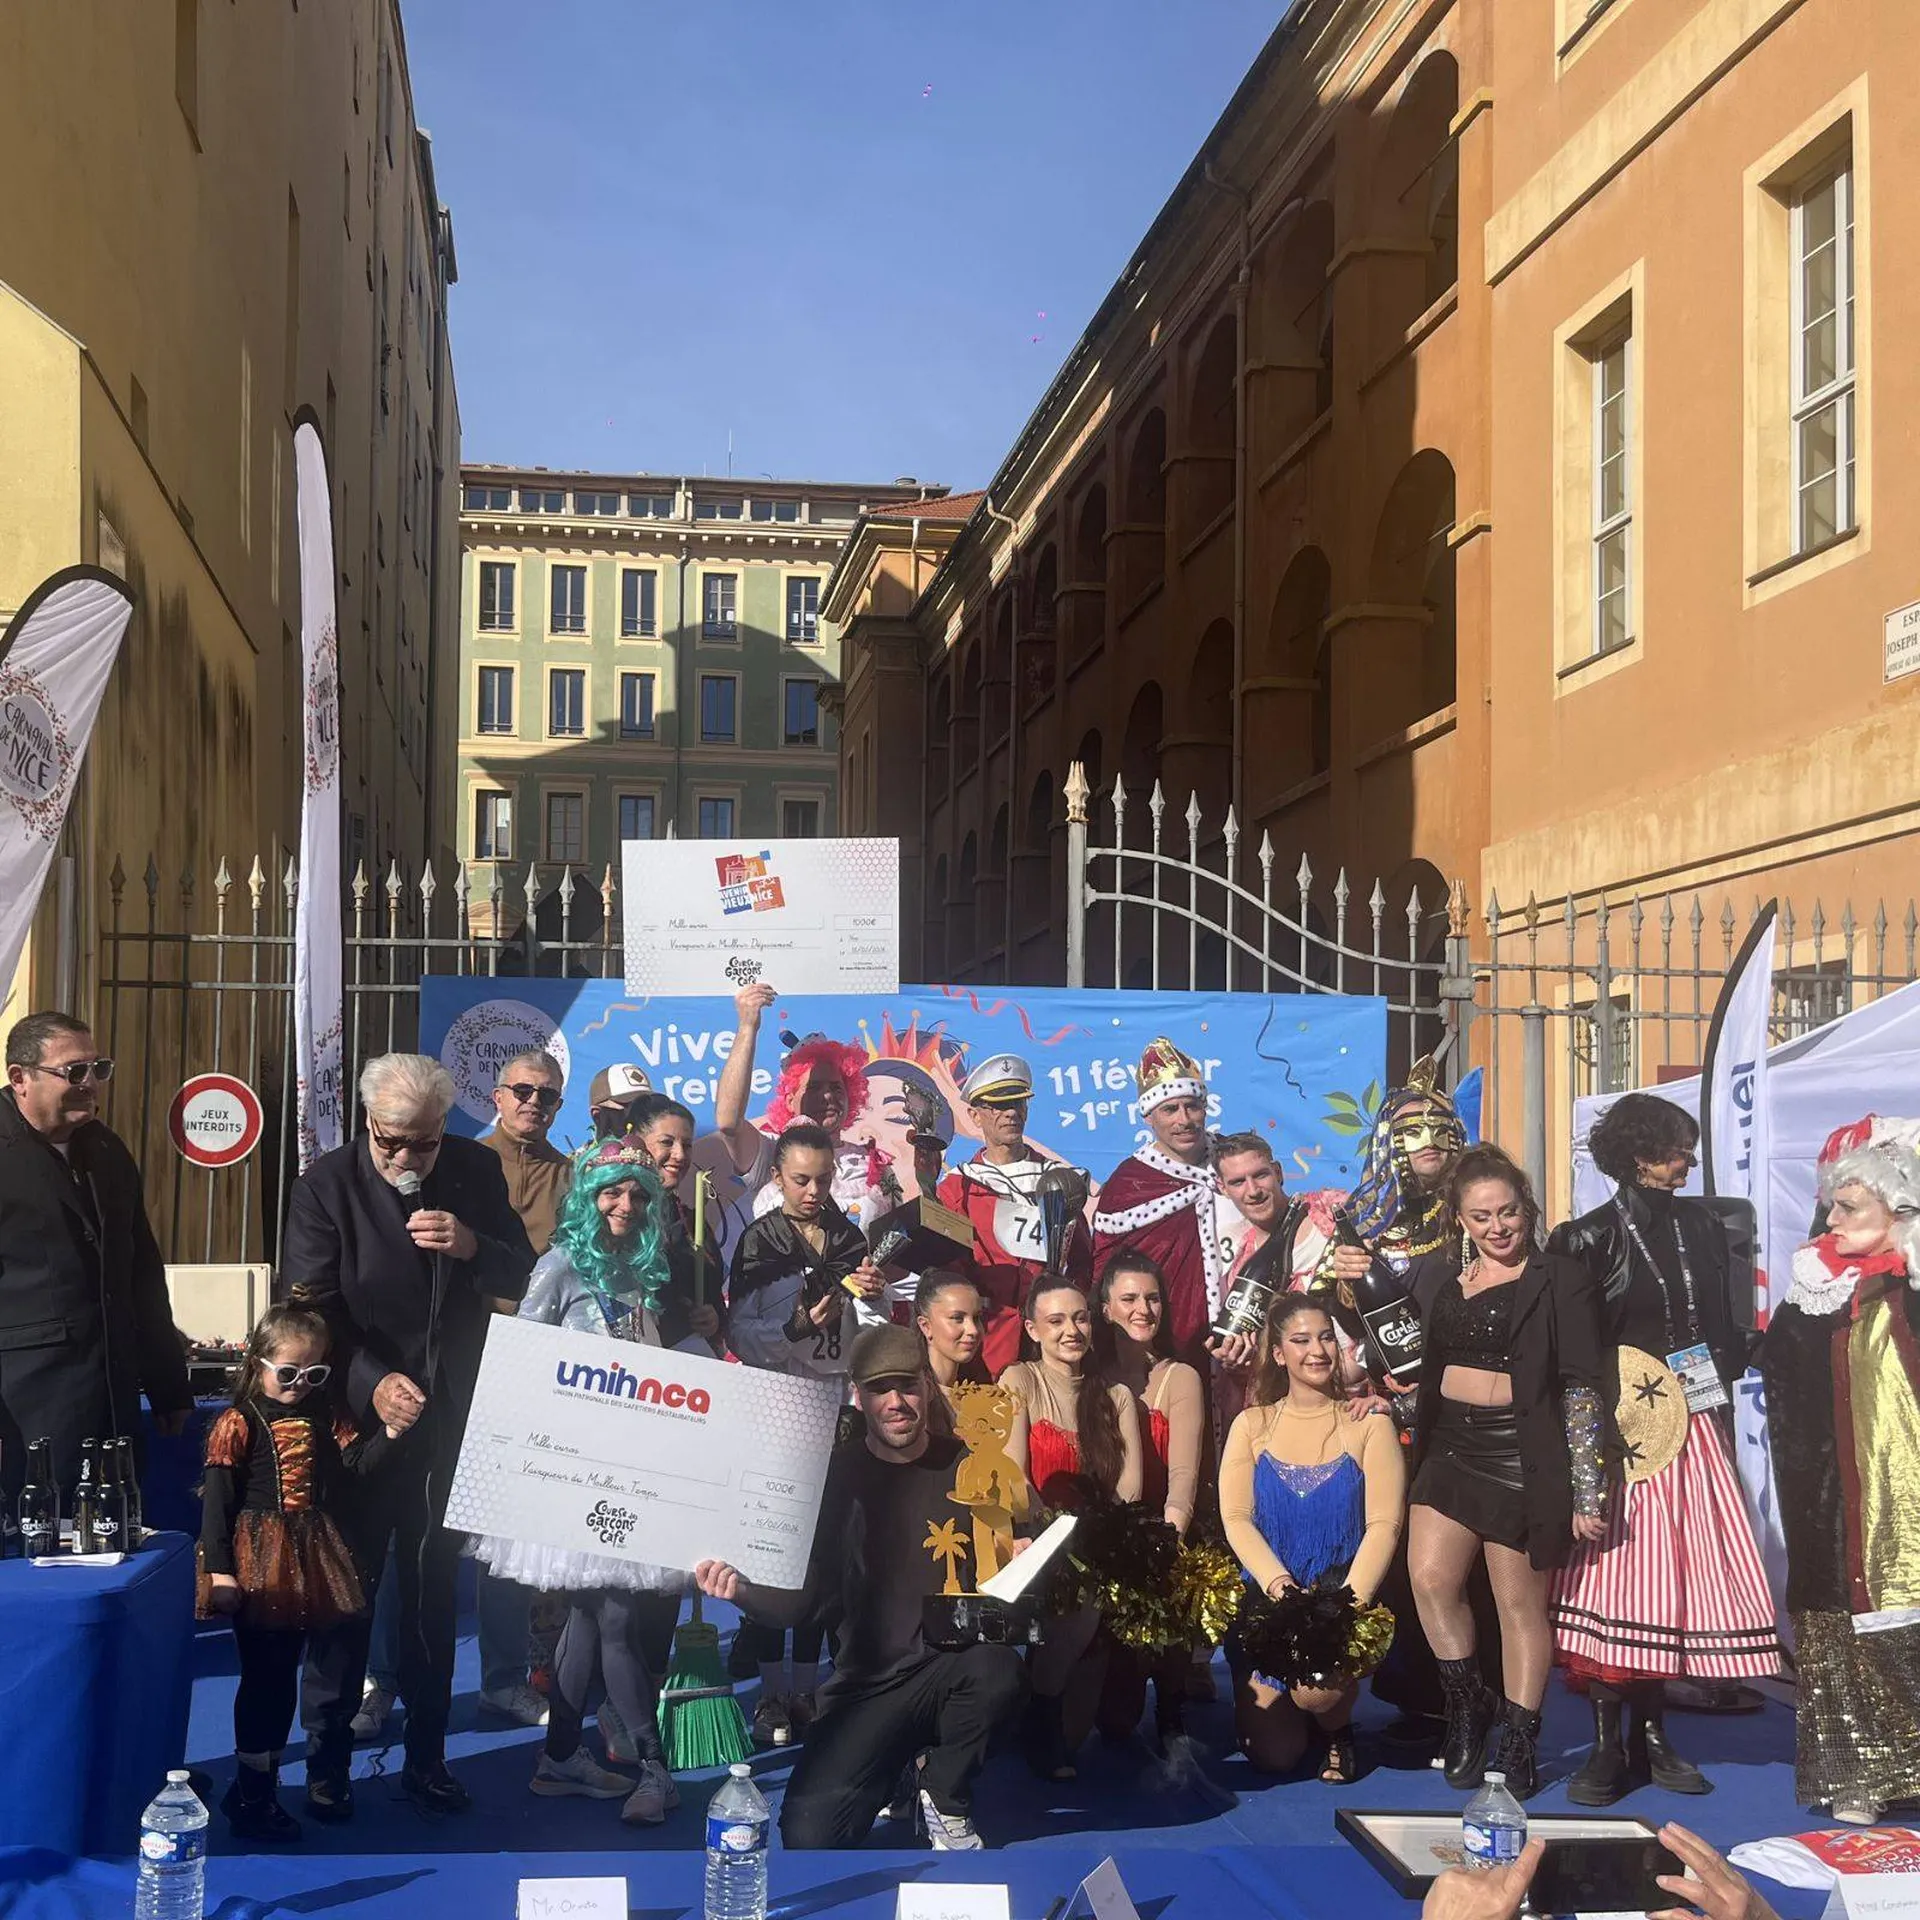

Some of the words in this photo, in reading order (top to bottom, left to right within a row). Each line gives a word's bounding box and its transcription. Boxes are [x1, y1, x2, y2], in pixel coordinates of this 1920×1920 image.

[1887, 633, 1918, 657] JOSEPH
[5, 702, 53, 762] CARNAVAL
[9, 735, 50, 791] NICE
[629, 1023, 736, 1067] Vive
[479, 1061, 490, 1073] DE
[663, 1066, 773, 1105] reie
[1047, 1065, 1081, 1096] 11
[201, 1109, 229, 1119] JEUX
[186, 1121, 242, 1133] INTERDITS
[1014, 1216, 1043, 1245] 74
[811, 1333, 842, 1360] 28
[595, 1499, 627, 1518] Course
[586, 1512, 636, 1532] Garçons
[600, 1530, 627, 1548] Café
